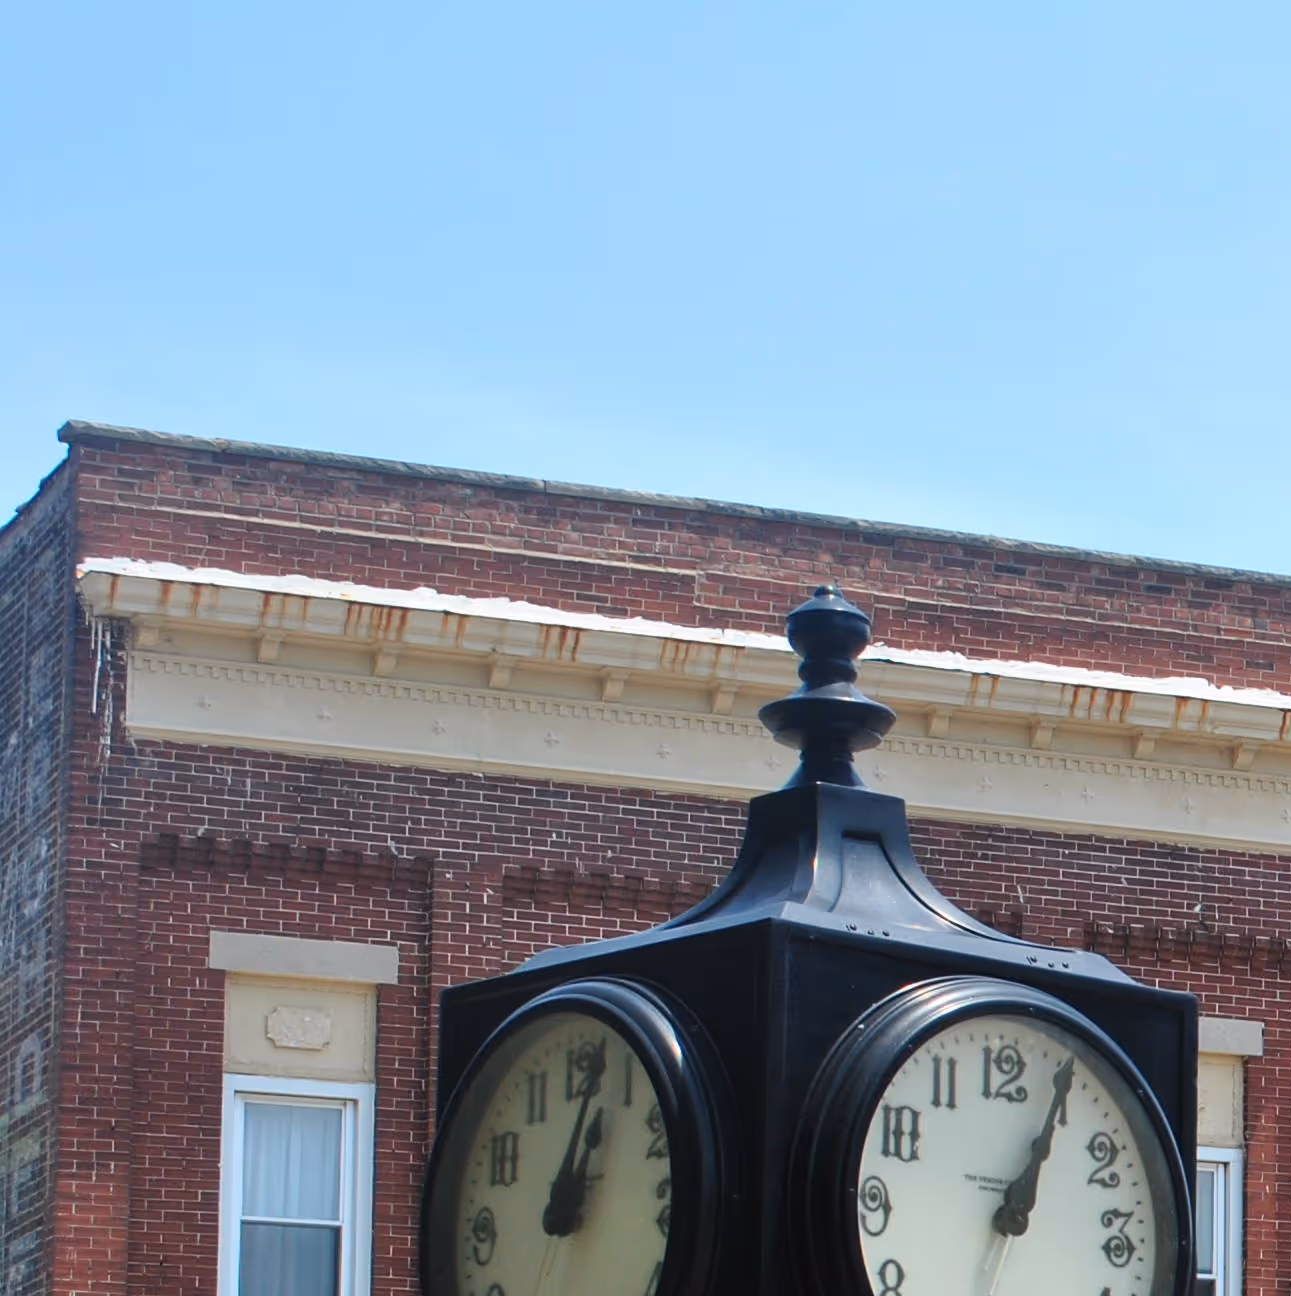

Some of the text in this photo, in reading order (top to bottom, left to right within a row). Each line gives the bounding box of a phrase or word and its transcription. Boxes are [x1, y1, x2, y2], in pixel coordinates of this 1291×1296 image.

[526, 1073, 548, 1125] 11
[930, 1056, 957, 1110] 11
[980, 1043, 1028, 1103] 12
[490, 1130, 519, 1187] 10
[880, 1103, 921, 1164] 10
[1086, 1131, 1120, 1189] 2
[471, 1206, 497, 1267] 9
[860, 1176, 893, 1237] 9
[1101, 1208, 1135, 1268] 3
